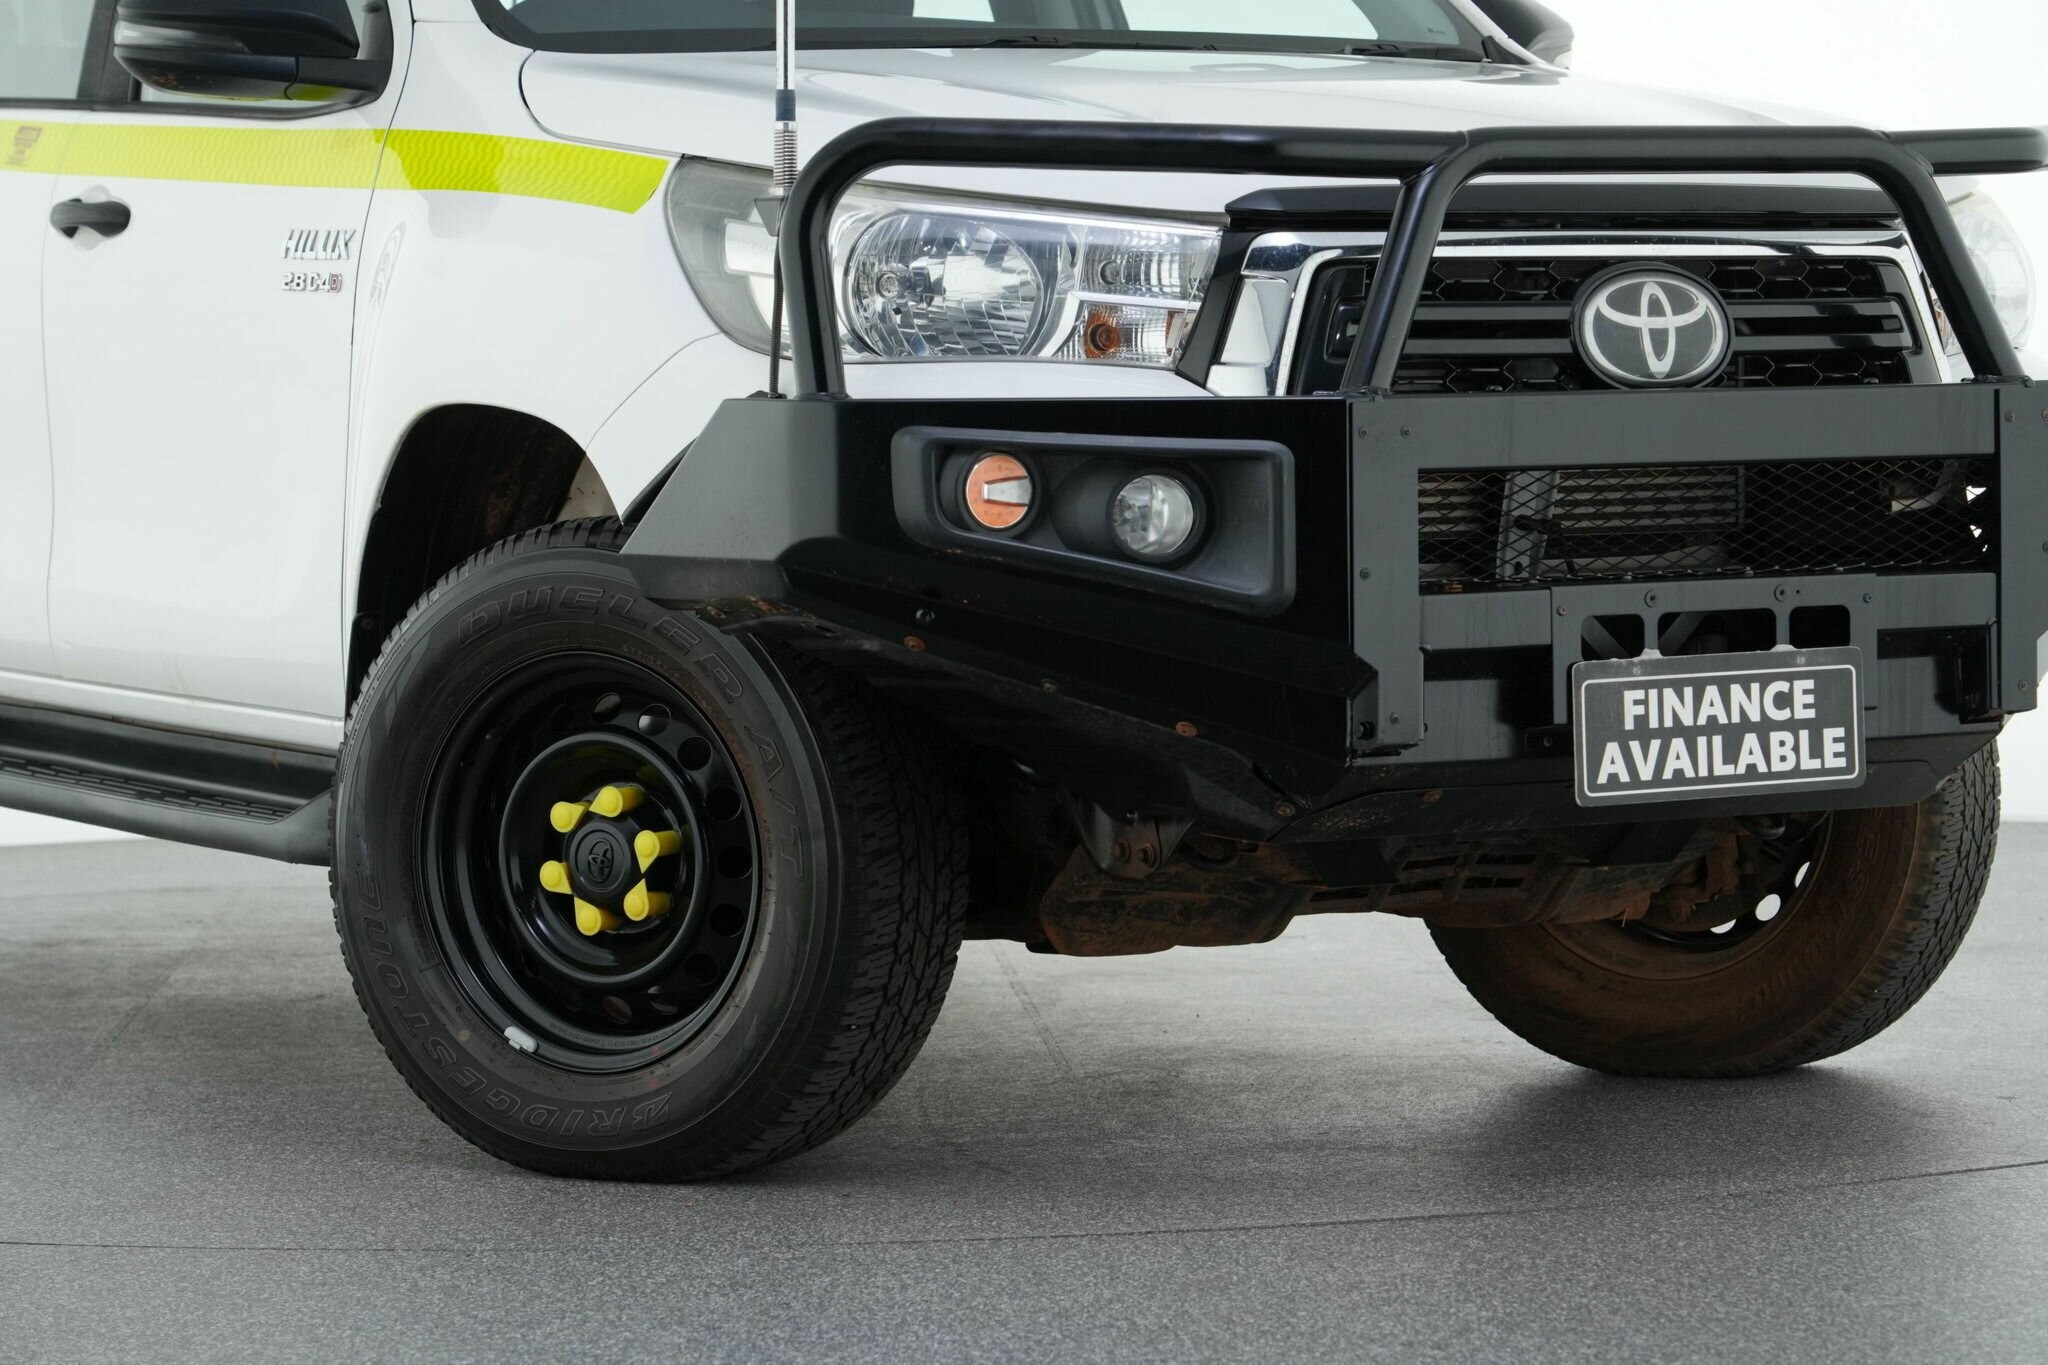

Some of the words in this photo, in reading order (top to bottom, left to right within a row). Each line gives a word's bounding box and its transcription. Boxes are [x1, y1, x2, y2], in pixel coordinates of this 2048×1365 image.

[281, 228, 357, 261] HILUX
[458, 584, 744, 704] DUELER
[1623, 679, 1816, 730] FINANCE
[1596, 727, 1847, 784] AVAILABLE
[355, 868, 674, 1137] BRIDGESTONE
